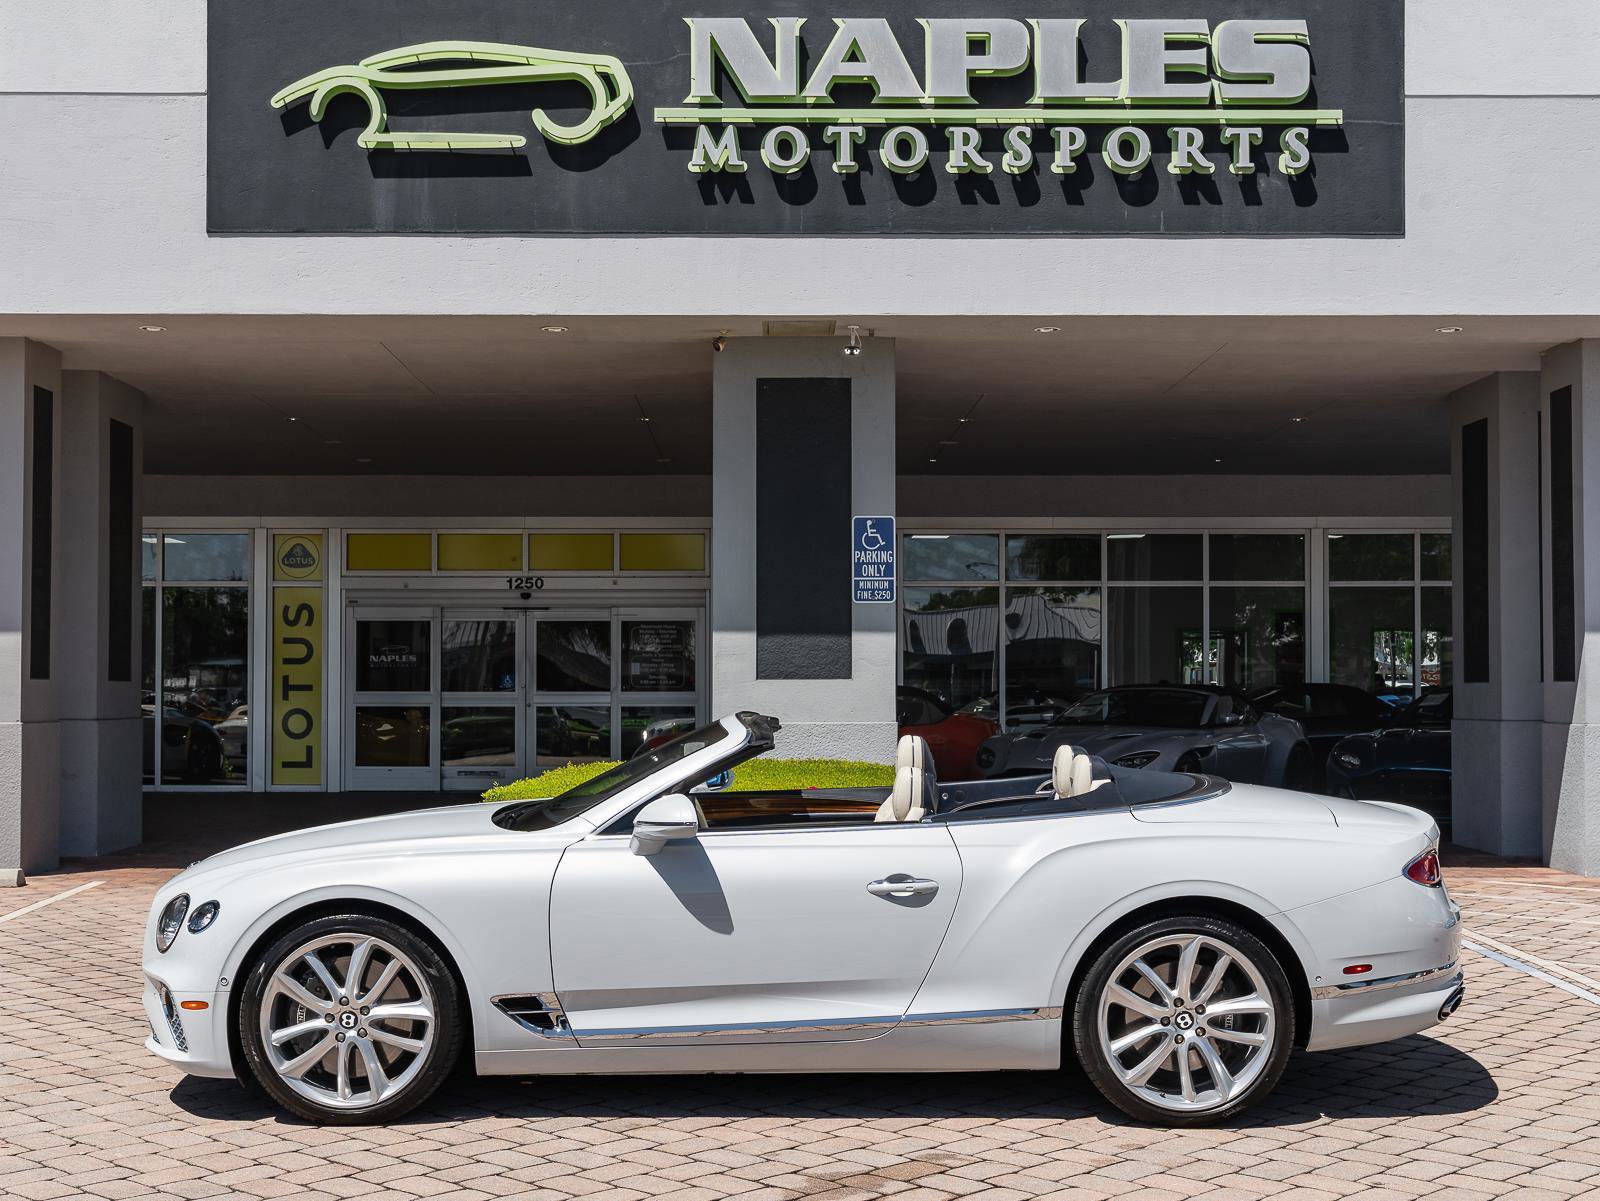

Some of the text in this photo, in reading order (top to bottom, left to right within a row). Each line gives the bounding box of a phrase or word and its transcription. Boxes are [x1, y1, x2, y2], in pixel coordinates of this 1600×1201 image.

[683, 17, 1311, 106] NAPLES
[689, 124, 1311, 174] MOTORSPORTS
[284, 557, 313, 565] LOTUS
[855, 551, 893, 562] PARKING
[862, 564, 885, 576] ONLY
[506, 576, 544, 589] 1250
[859, 581, 889, 589] MINIMUM
[857, 591, 891, 601] FINE $250
[282, 602, 314, 768] LOTUS
